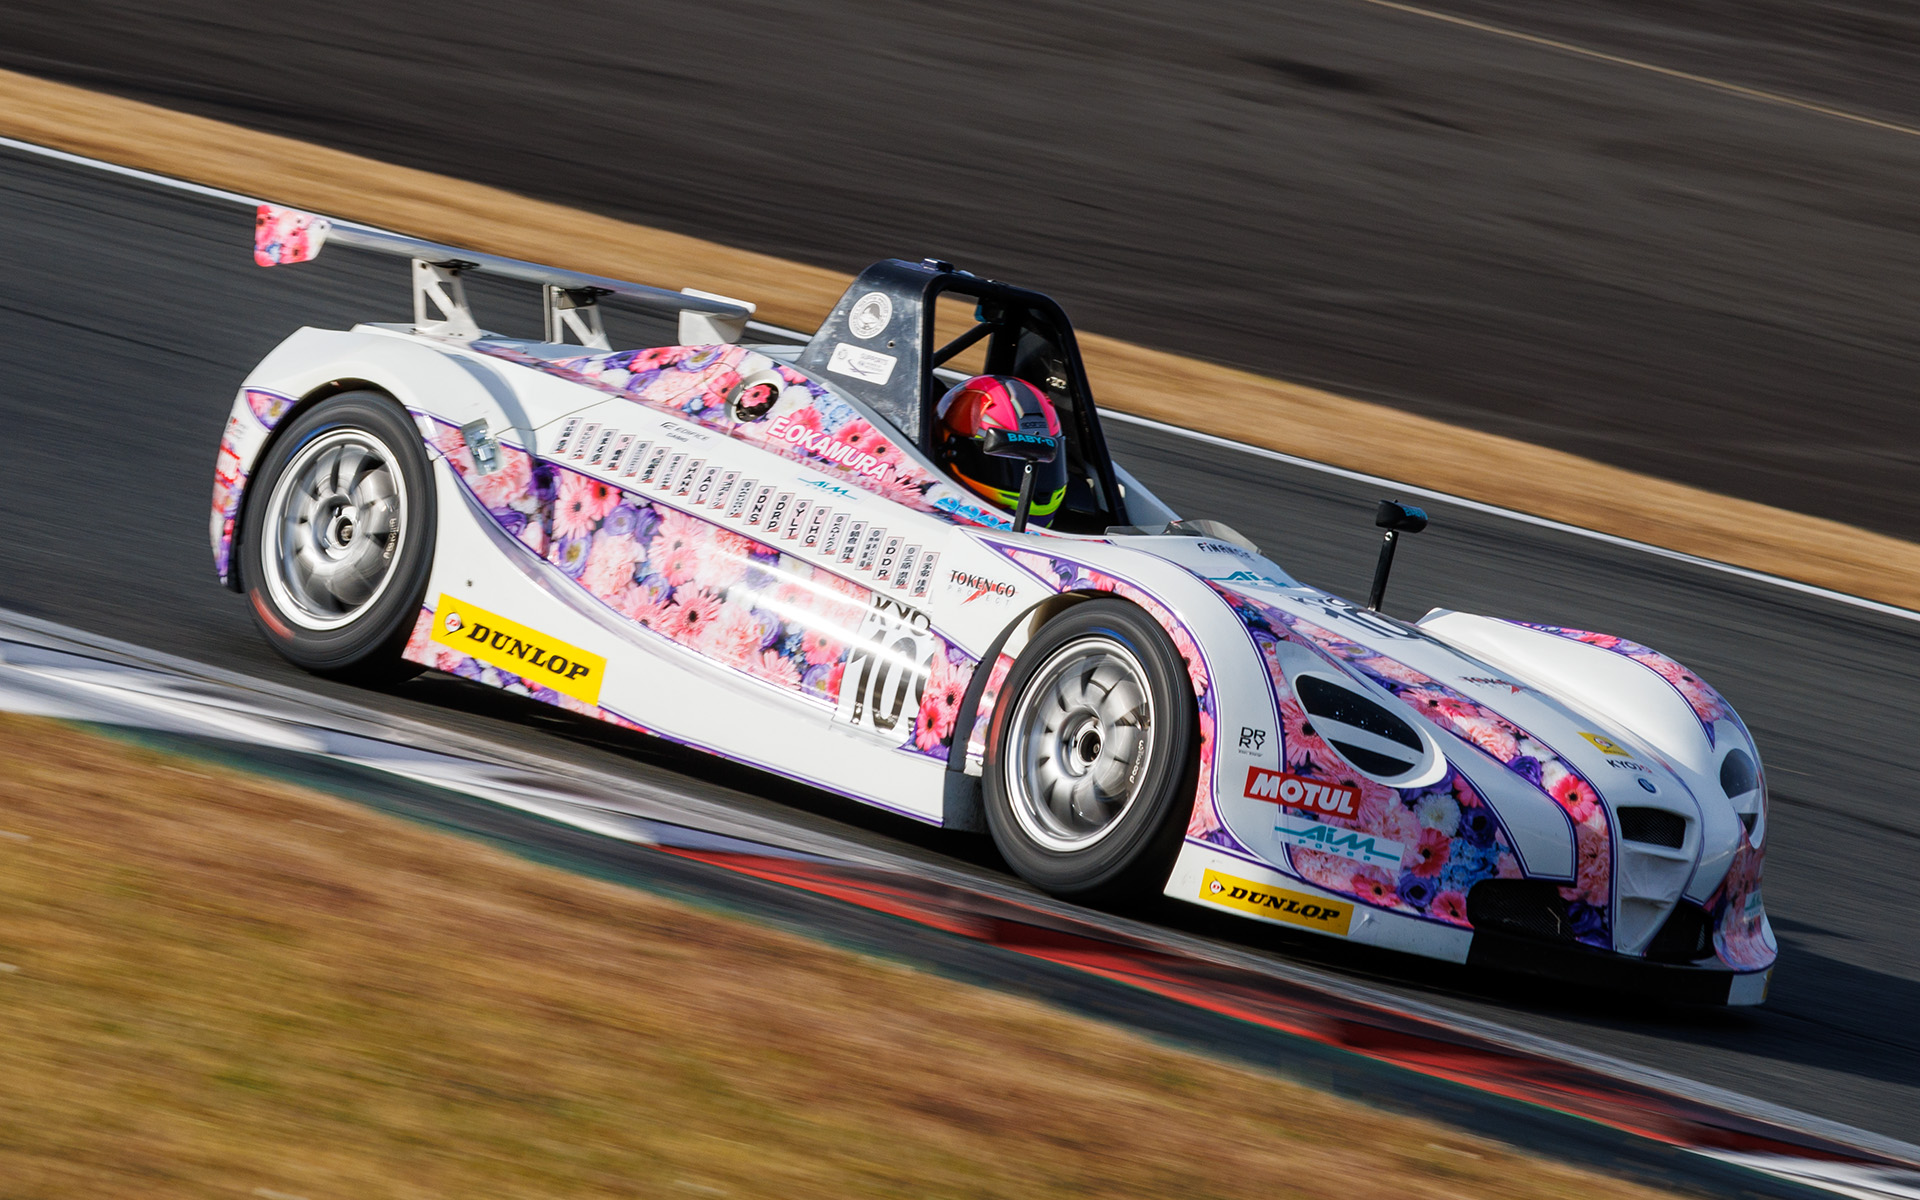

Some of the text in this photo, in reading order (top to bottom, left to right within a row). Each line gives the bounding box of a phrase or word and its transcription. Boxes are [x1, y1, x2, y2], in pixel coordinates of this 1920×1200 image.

[768, 417, 890, 481] E.OKAMURA
[749, 495, 767, 523] DNS
[767, 502, 786, 530] DRP
[788, 508, 805, 537] YLT
[805, 516, 820, 545] LHG
[950, 569, 993, 592] TOKEN
[995, 582, 1016, 598] GO
[467, 623, 590, 680] DUNLOP
[1250, 773, 1354, 815] MOTUL
[1227, 886, 1340, 921] DUNLOP
